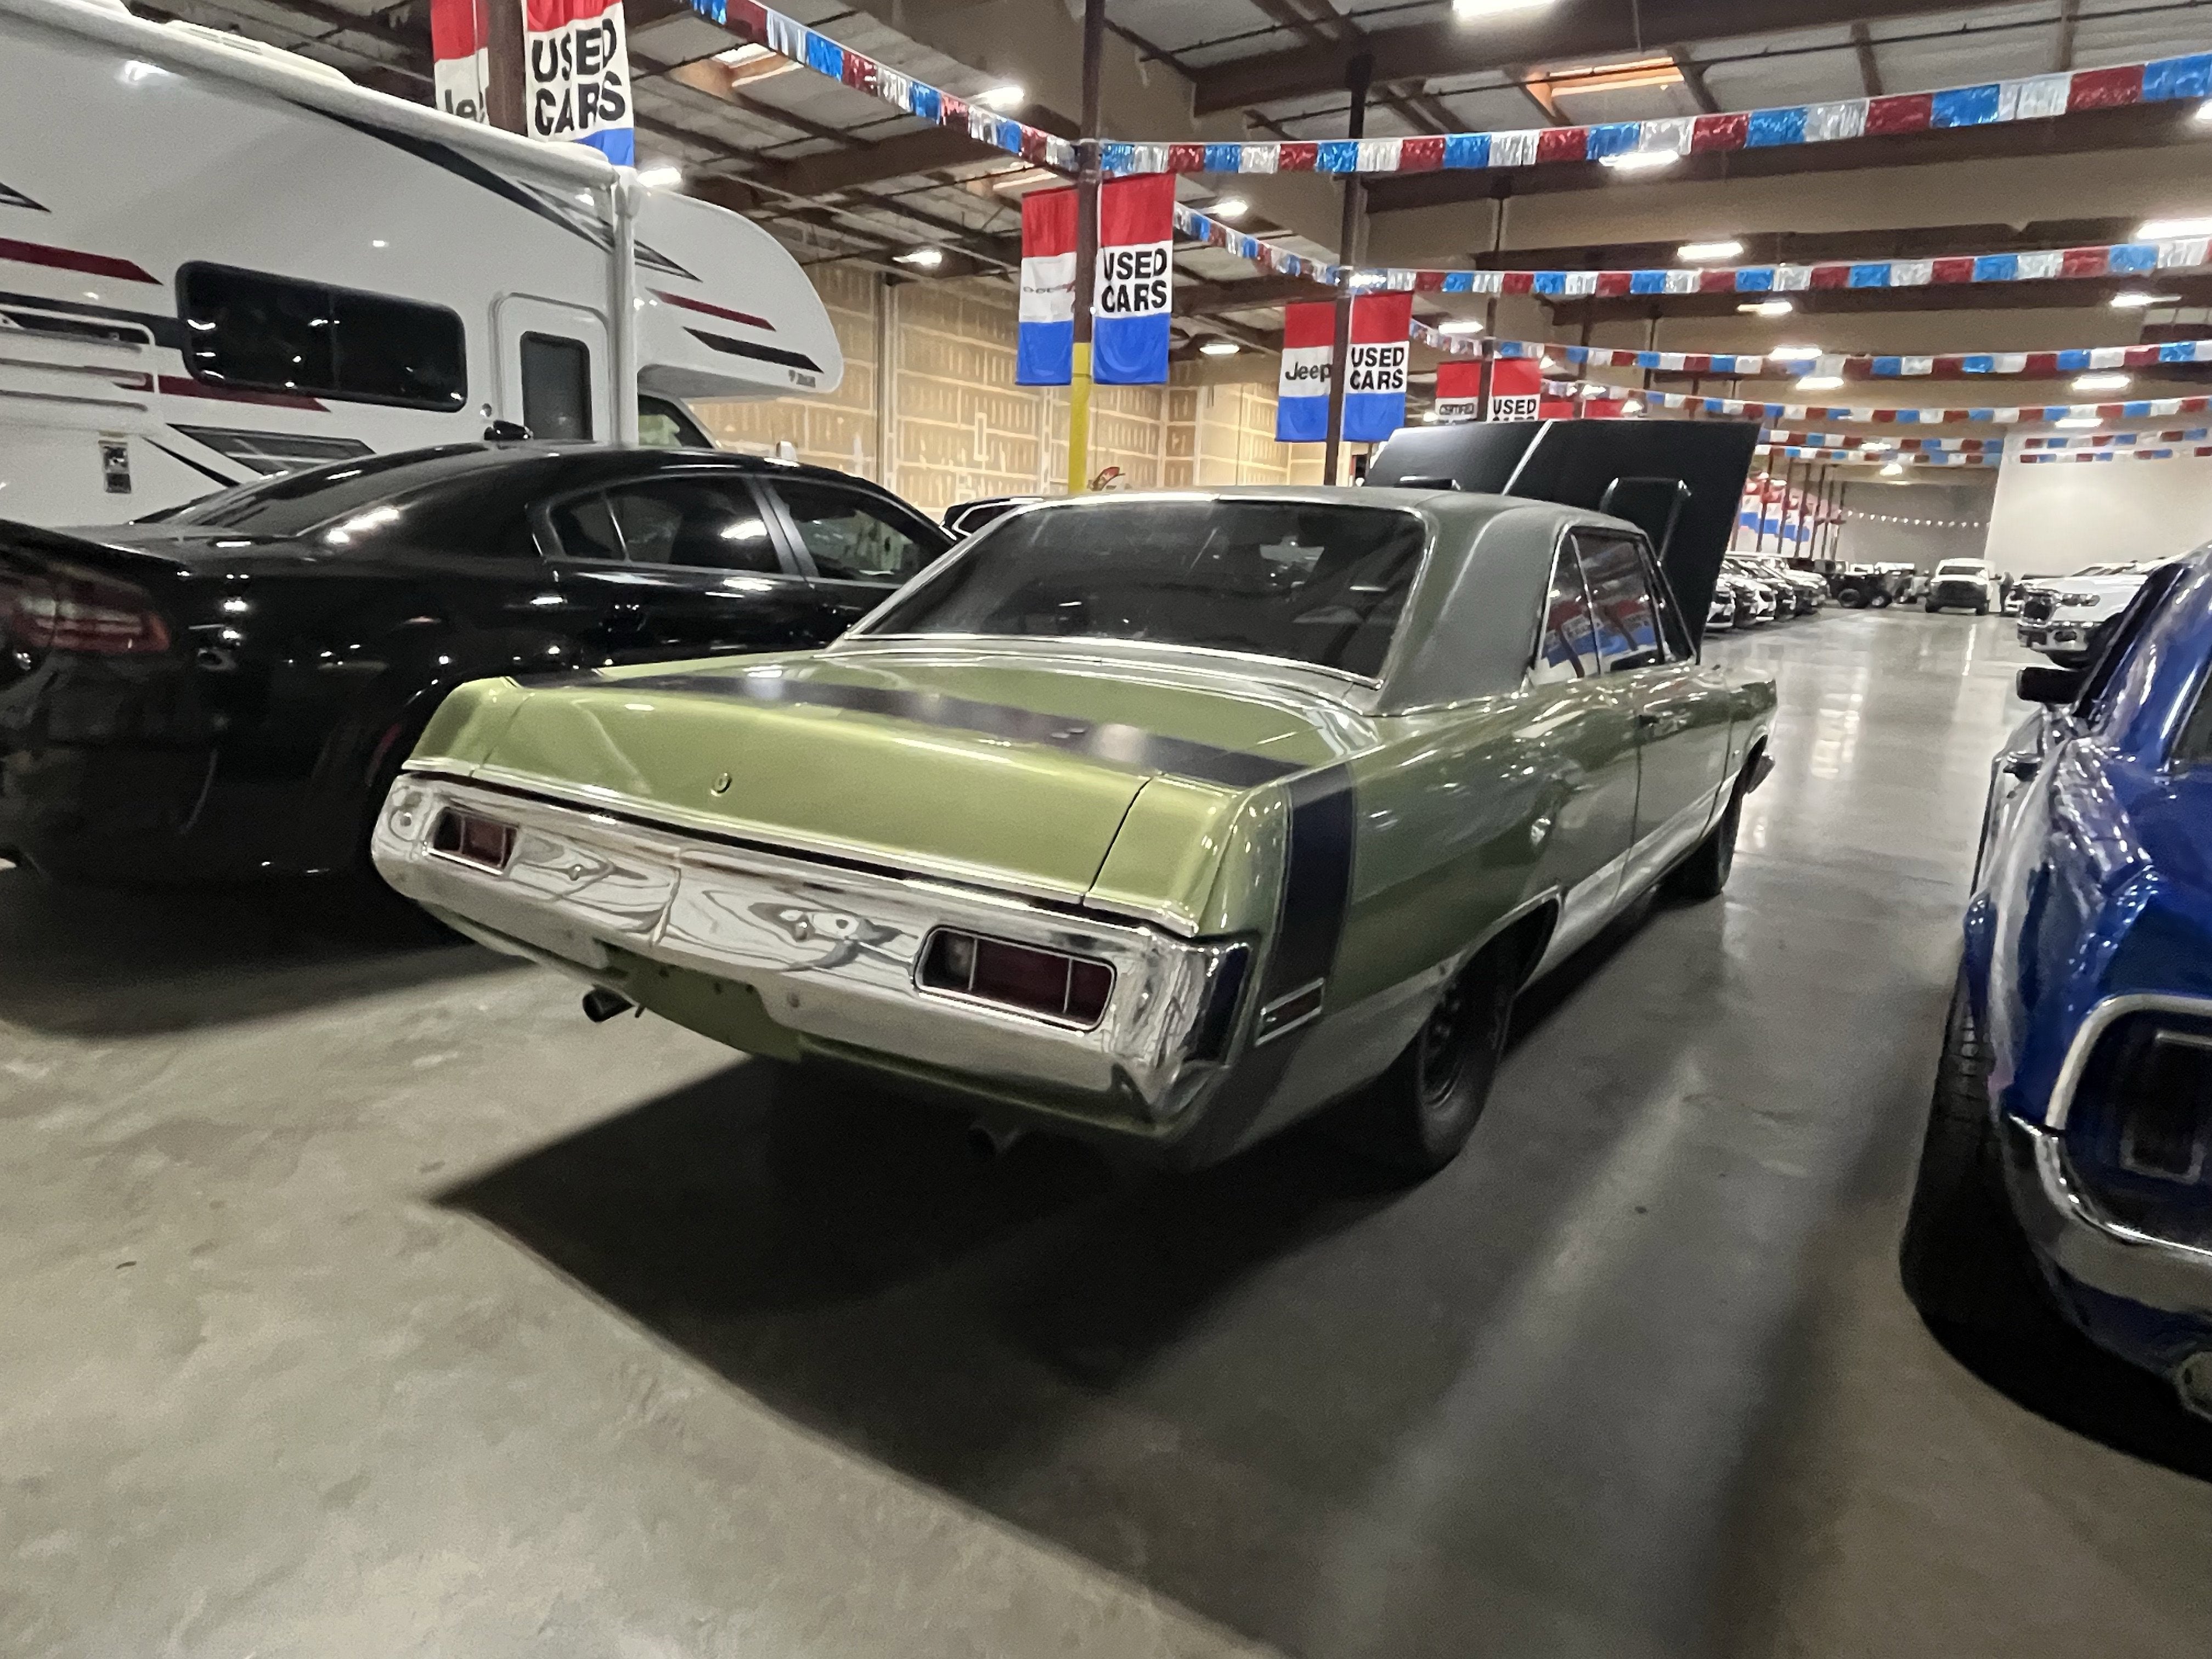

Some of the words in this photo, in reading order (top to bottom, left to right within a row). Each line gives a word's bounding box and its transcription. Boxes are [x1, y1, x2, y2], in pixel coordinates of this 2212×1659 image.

[532, 18, 617, 82] USED
[535, 71, 625, 136] CARS
[1103, 248, 1167, 280] USED
[1102, 280, 1167, 313] CARS
[1351, 347, 1405, 368] USED
[1285, 361, 1333, 382] Jeep
[1350, 369, 1403, 390] CARS
[1493, 399, 1537, 415] USED
